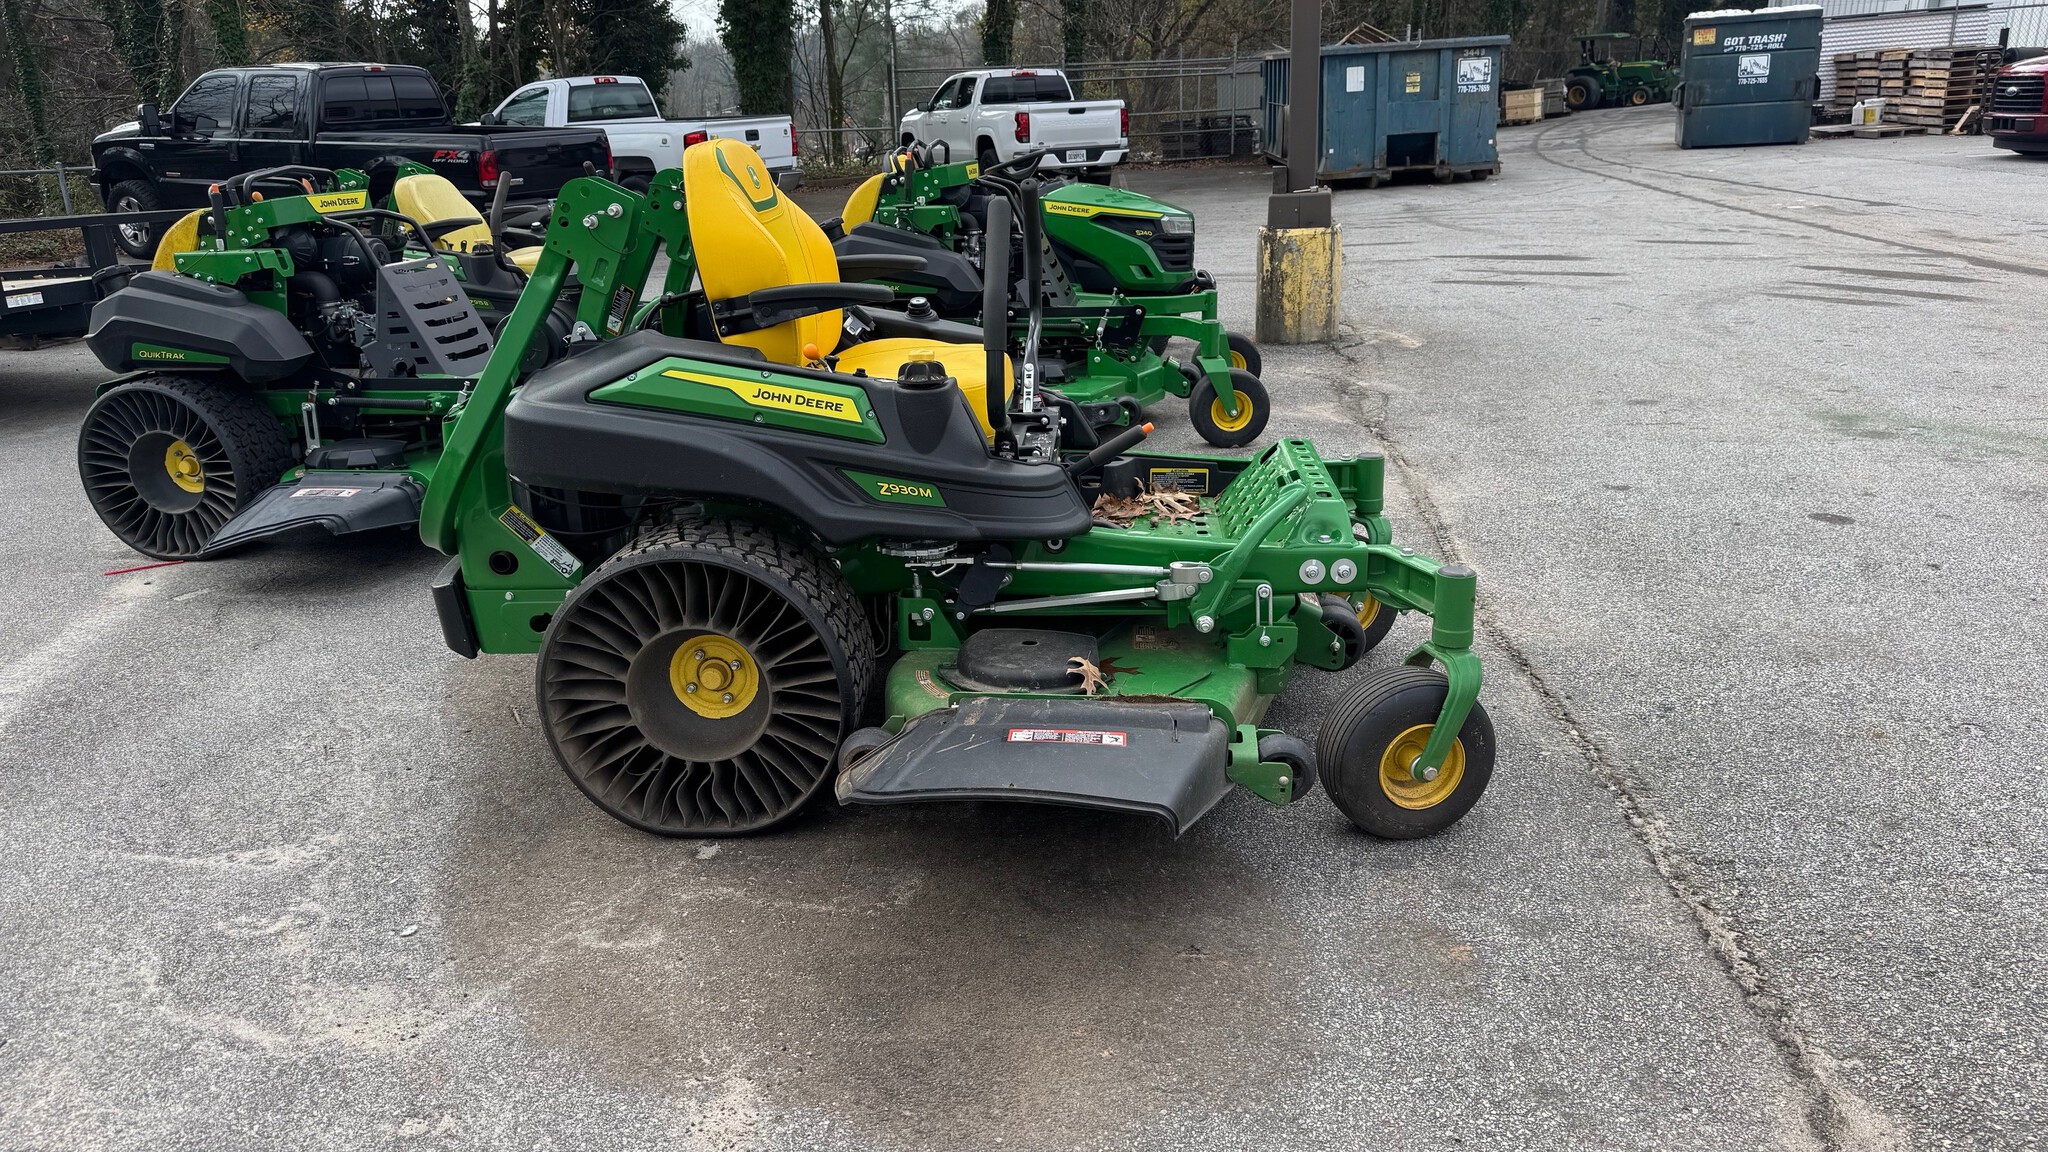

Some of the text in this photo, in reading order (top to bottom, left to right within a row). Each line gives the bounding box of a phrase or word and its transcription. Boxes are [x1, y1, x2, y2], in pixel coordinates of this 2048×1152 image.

[1723, 36, 1746, 46] GOT
[1748, 33, 1788, 44] TRASH?
[1463, 48, 1486, 56] 3449
[1734, 42, 1784, 52] 770-725-ROLL
[1457, 85, 1490, 93] 770-725-7655
[433, 150, 470, 159] FX4
[319, 197, 360, 208] JOHN DEERE
[1049, 203, 1090, 214] JOHN DEERE
[752, 388, 844, 412] JOHN DEERE
